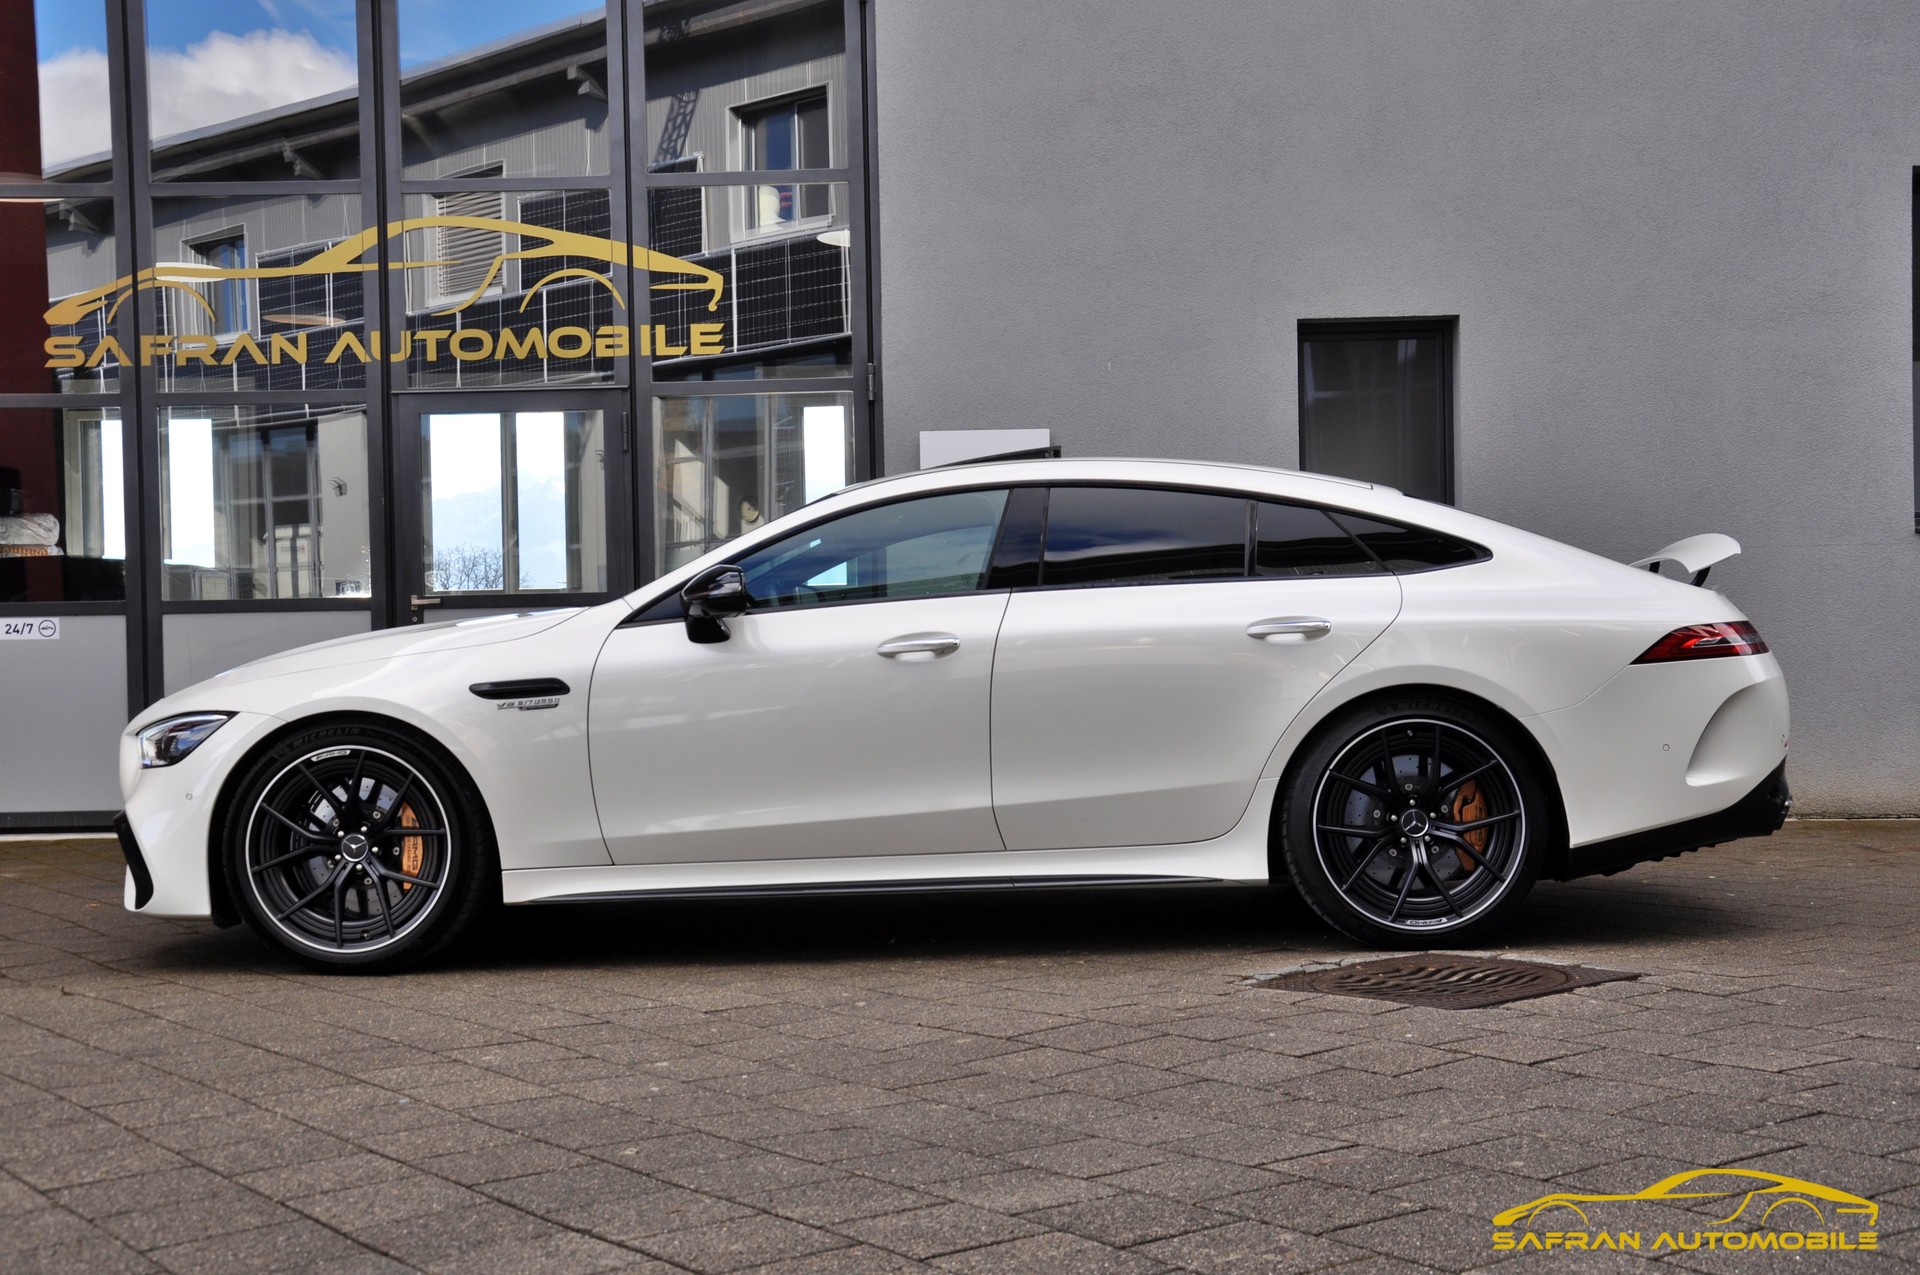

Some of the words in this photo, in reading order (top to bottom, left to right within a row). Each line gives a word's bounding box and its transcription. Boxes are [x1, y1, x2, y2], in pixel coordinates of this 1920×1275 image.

[44, 330, 308, 369] SAFRAN
[324, 322, 725, 364] AUTOMOBILE
[5, 623, 33, 635] 24/7
[292, 726, 361, 749] MICHELIN
